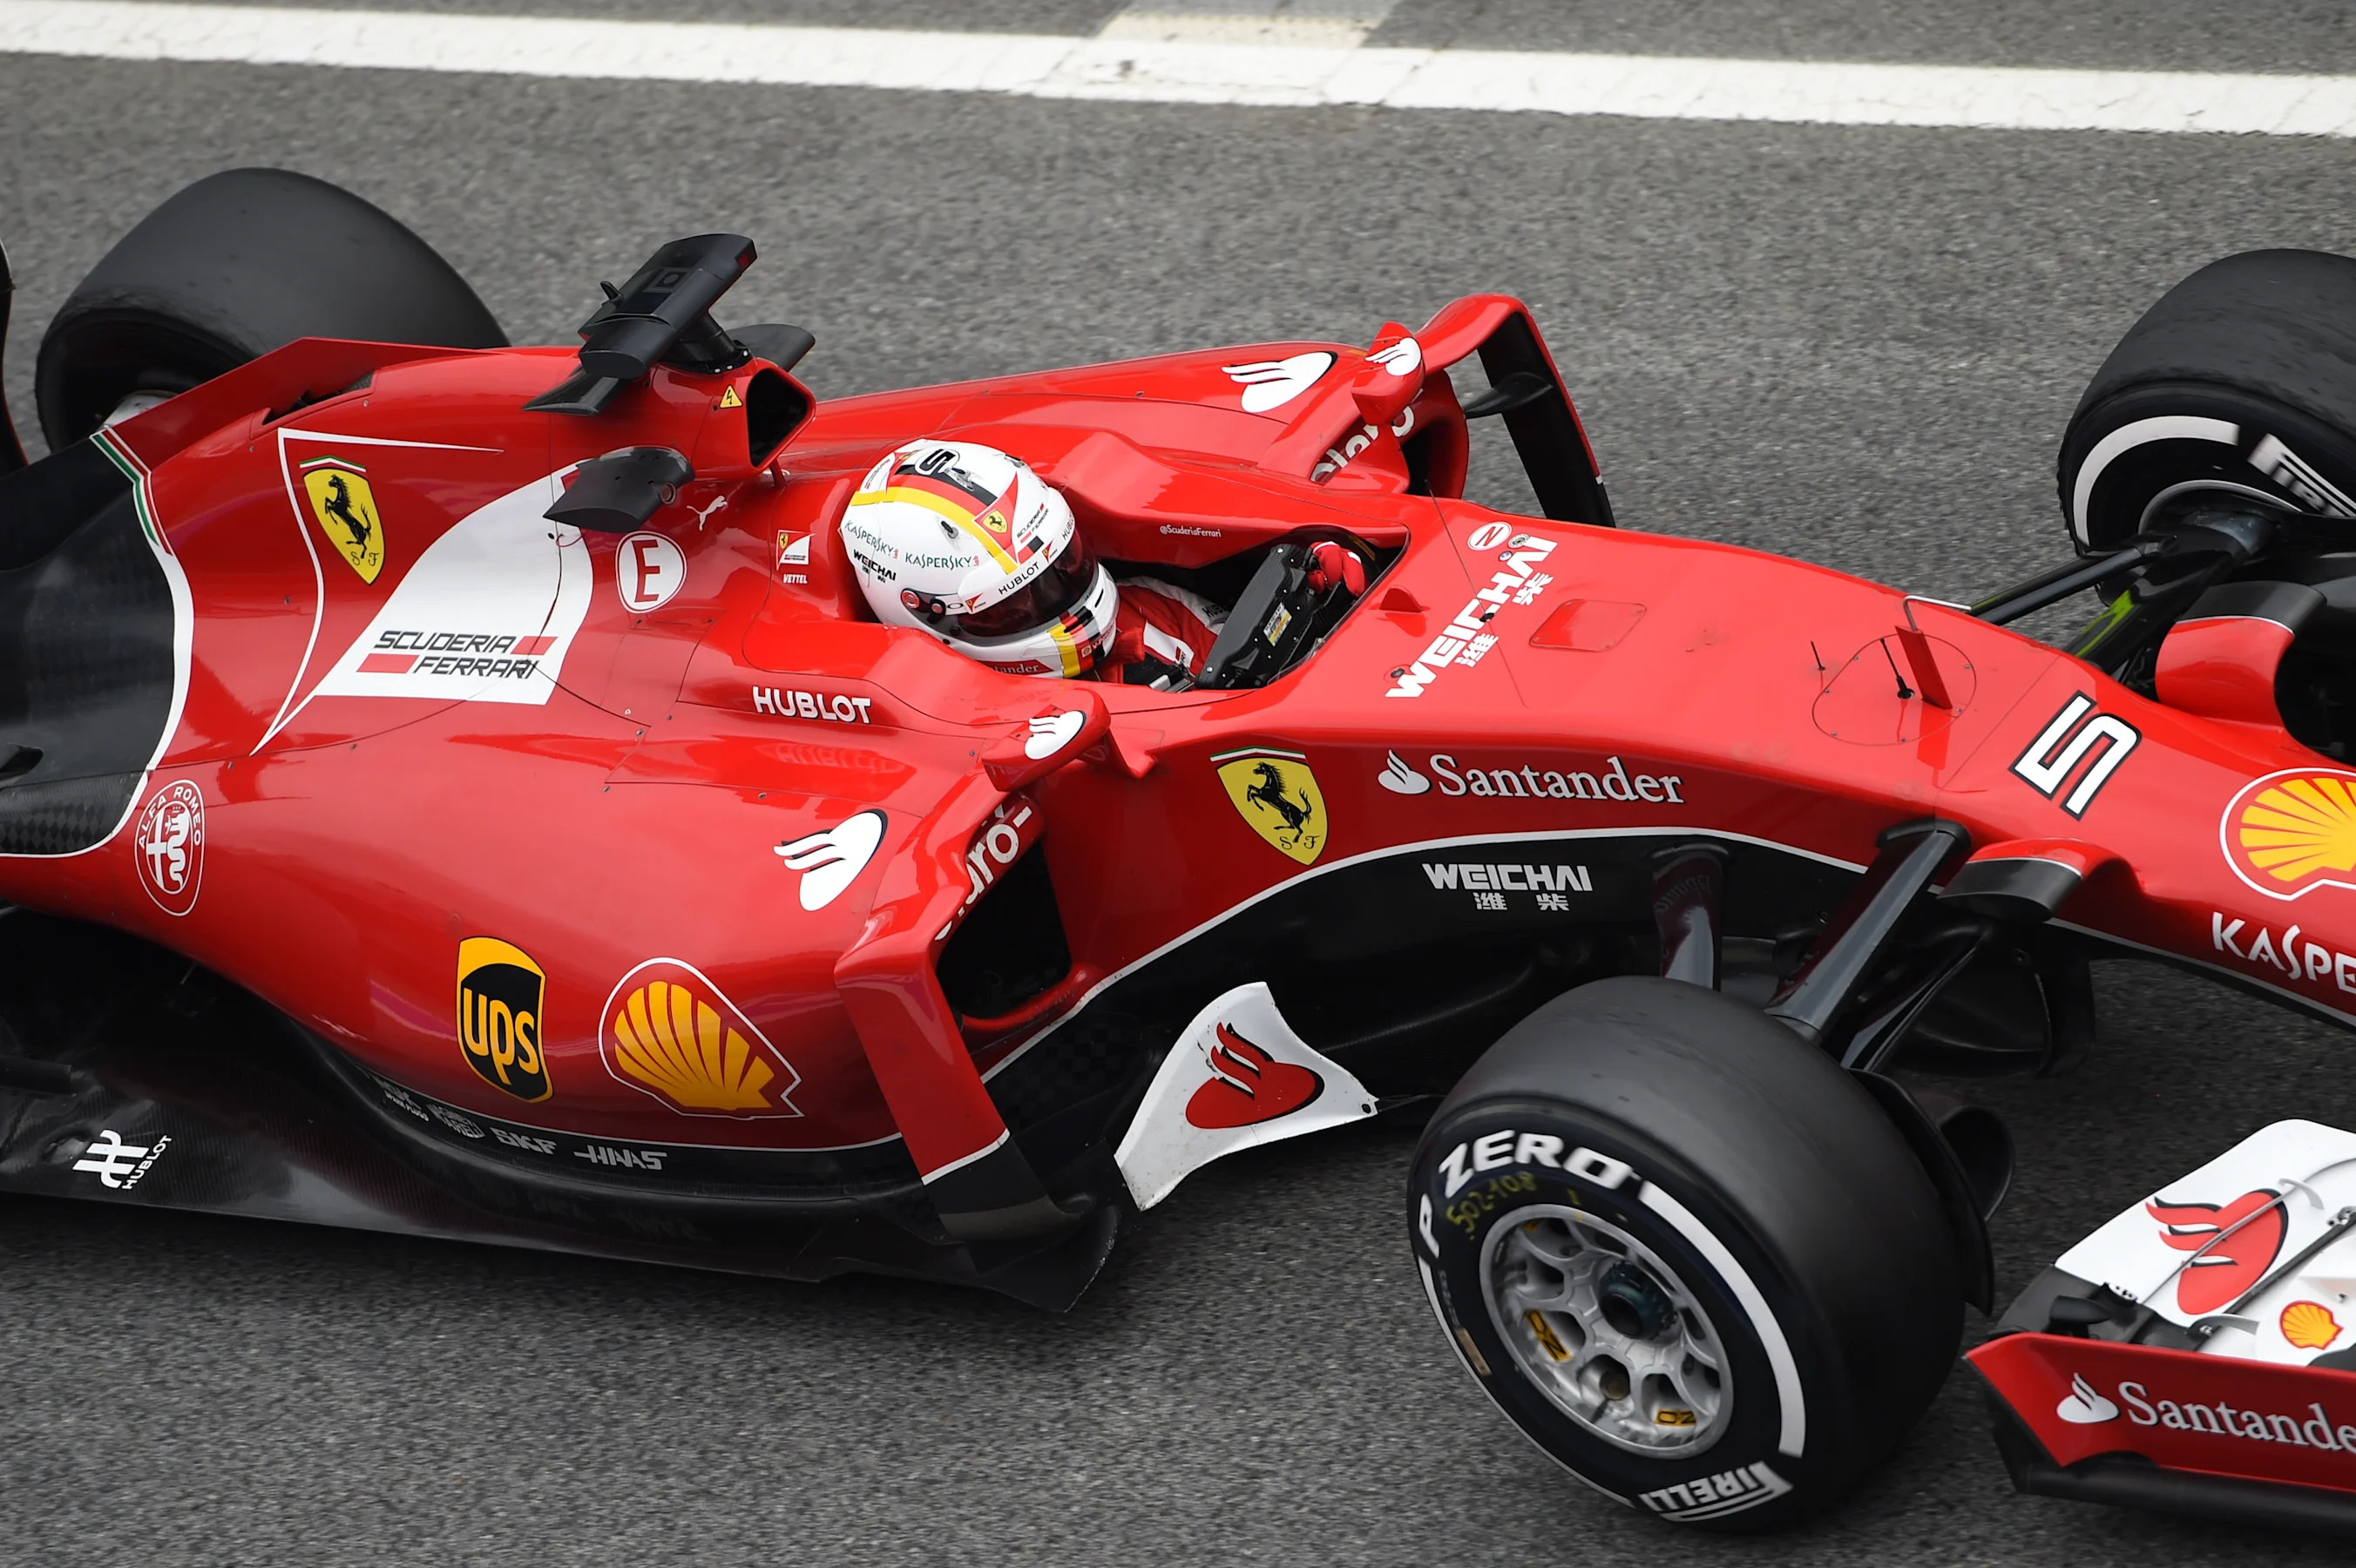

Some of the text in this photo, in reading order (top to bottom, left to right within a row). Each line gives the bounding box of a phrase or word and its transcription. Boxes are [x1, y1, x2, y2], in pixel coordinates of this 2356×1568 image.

[844, 520, 894, 556] KASPERSKY
[1160, 525, 1222, 537] @ScuderiaFerrari
[1474, 526, 1504, 546] N
[631, 539, 660, 603] E
[783, 573, 809, 585] VETTEL
[853, 549, 897, 582] WEICHAI
[904, 552, 972, 571] KASPERSKY
[999, 562, 1039, 596] HUBLOT
[1384, 536, 1557, 697] WEICHAI
[374, 630, 517, 653] SCUDERIA
[412, 656, 540, 679] FERRARI
[753, 686, 871, 725] HUBLOT
[2007, 690, 2143, 821] 5
[1429, 754, 1685, 804] Santander
[138, 786, 201, 850] ALFA ROMEO
[1422, 862, 1594, 892] WEICHAI
[464, 987, 539, 1087] ups
[490, 1126, 558, 1155] SKF
[574, 1145, 668, 1171] HAAS
[122, 1134, 173, 1190] HUBLOT
[1418, 1130, 1635, 1258] P ZERO
[1639, 1461, 1793, 1522] PIRELLI
